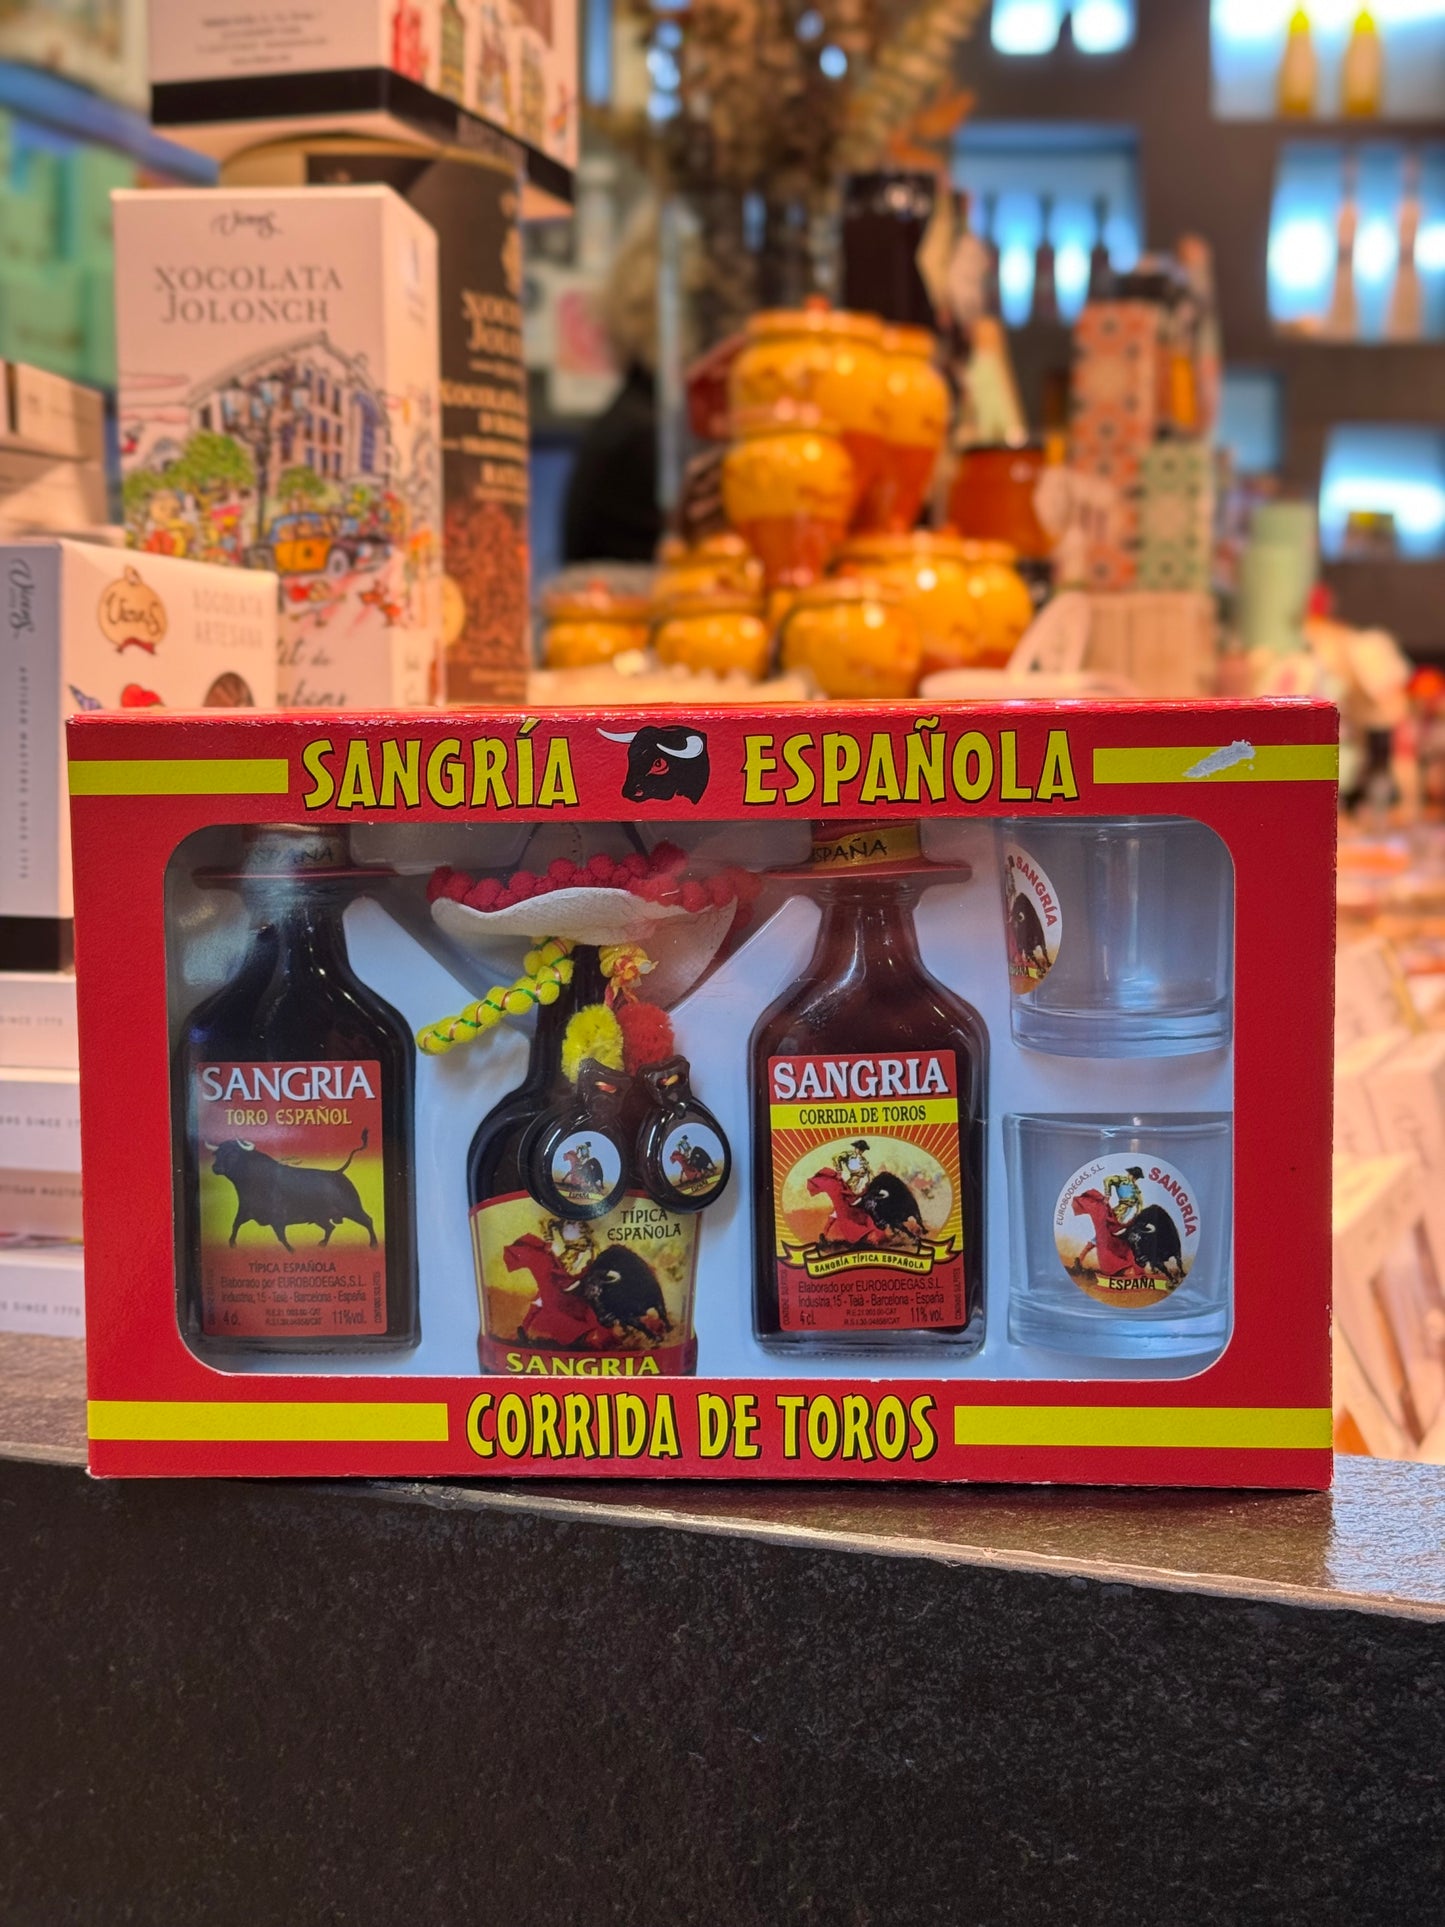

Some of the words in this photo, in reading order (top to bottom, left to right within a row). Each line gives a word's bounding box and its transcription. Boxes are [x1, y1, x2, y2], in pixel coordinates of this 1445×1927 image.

[155, 265, 342, 291] XOCOLATA
[161, 292, 328, 323] JOLONCH
[302, 716, 580, 811] SANGRÍA
[741, 715, 1080, 806] ESPAÑOLA
[1015, 856, 1058, 927] SANGRÍA
[202, 1065, 376, 1102] SANGRIA
[773, 1057, 950, 1100] SANGRIA
[225, 1109, 268, 1126] TORO
[275, 1106, 352, 1125] ESPAÑOL
[799, 1108, 856, 1125] CORRIDA
[861, 1108, 879, 1123] DE
[882, 1105, 926, 1122] TOROS
[1149, 1167, 1199, 1238] SANGRÍA
[620, 1206, 668, 1224] TÍPICA
[606, 1223, 682, 1241] ESPAÑOLA
[249, 1262, 280, 1273] TÍPICA
[283, 1260, 336, 1273] ESPAÑOLA
[814, 1255, 849, 1273] SANGRÍA
[852, 1252, 879, 1264] TÍPICA
[882, 1254, 925, 1270] ESPAÑOLA
[798, 1279, 839, 1293] Elaborado
[840, 1283, 855, 1296] por
[1109, 1277, 1156, 1291] ESPAÑA
[871, 1293, 908, 1307] Barcelona
[505, 1352, 661, 1376] SANGRIA
[465, 1391, 683, 1460] CORRIDA
[697, 1391, 763, 1460] DE
[776, 1391, 939, 1463] TOROS
